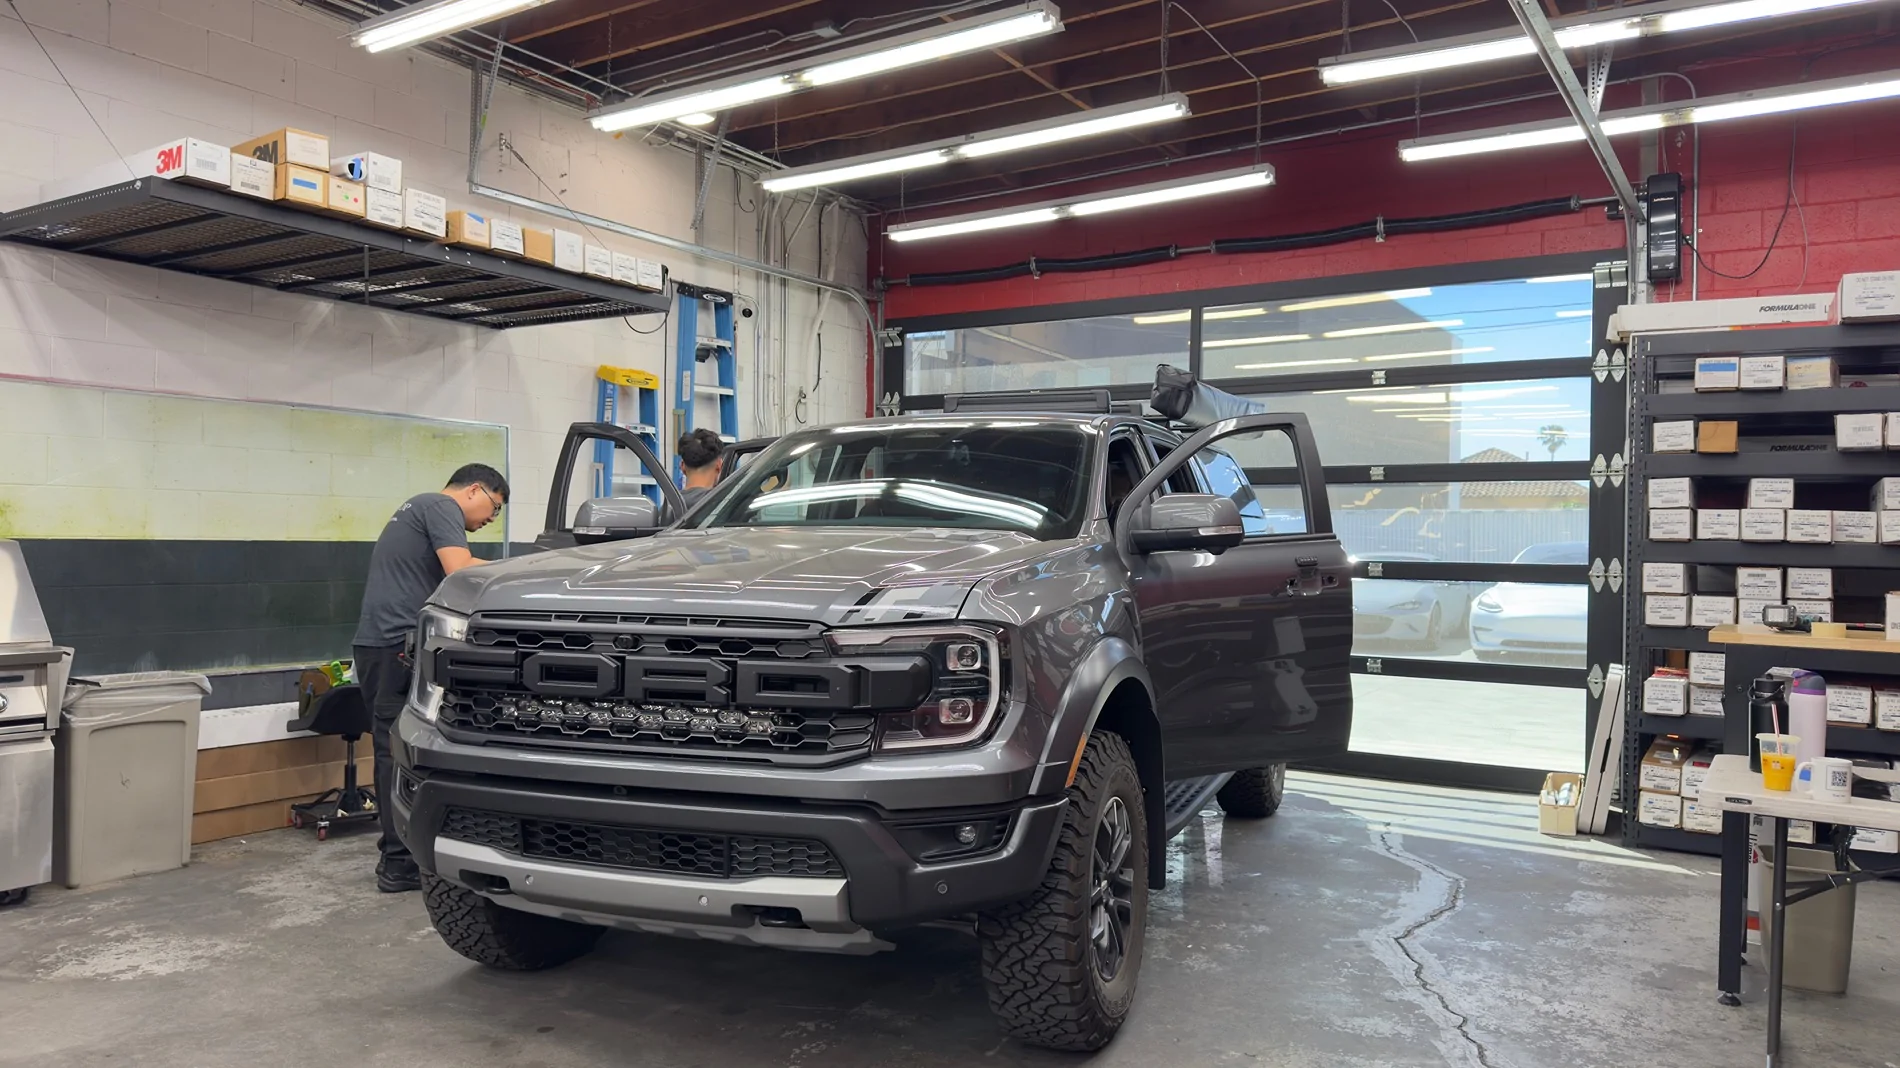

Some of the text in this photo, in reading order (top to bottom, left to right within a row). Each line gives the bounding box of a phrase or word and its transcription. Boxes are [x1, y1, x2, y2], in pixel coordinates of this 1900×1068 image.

[156, 145, 182, 174] 3M
[1759, 303, 1816, 312] FORMULAONE
[436, 648, 856, 708] FORD
